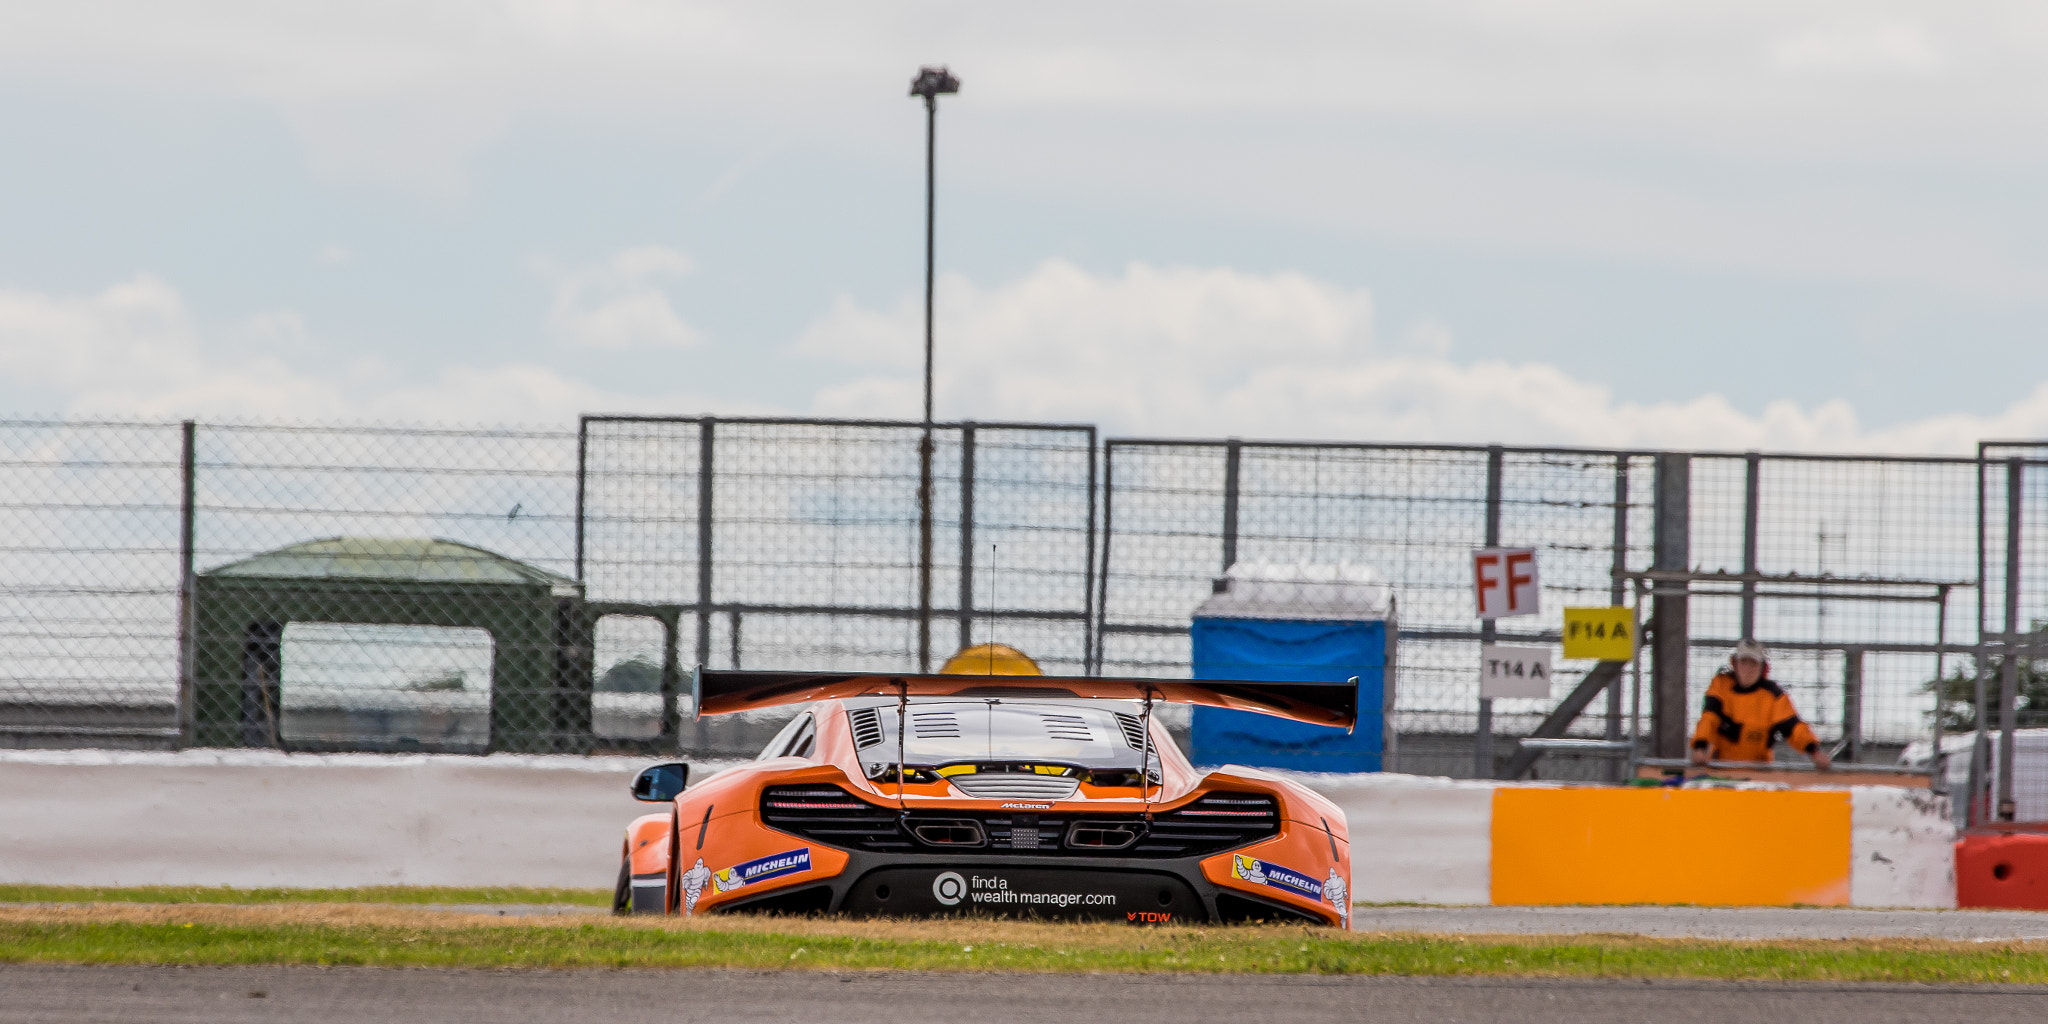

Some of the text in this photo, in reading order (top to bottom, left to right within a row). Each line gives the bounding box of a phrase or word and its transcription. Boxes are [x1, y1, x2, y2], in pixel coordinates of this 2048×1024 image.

[1475, 552, 1532, 613] FF
[1611, 622, 1628, 640] A
[1488, 659, 1546, 678] T14 A
[745, 853, 809, 877] MICHELIN
[971, 876, 1008, 890] find a
[1268, 870, 1321, 894] MICHELIN
[971, 890, 1116, 907] wealth manager.com
[1138, 912, 1171, 922] TOW
